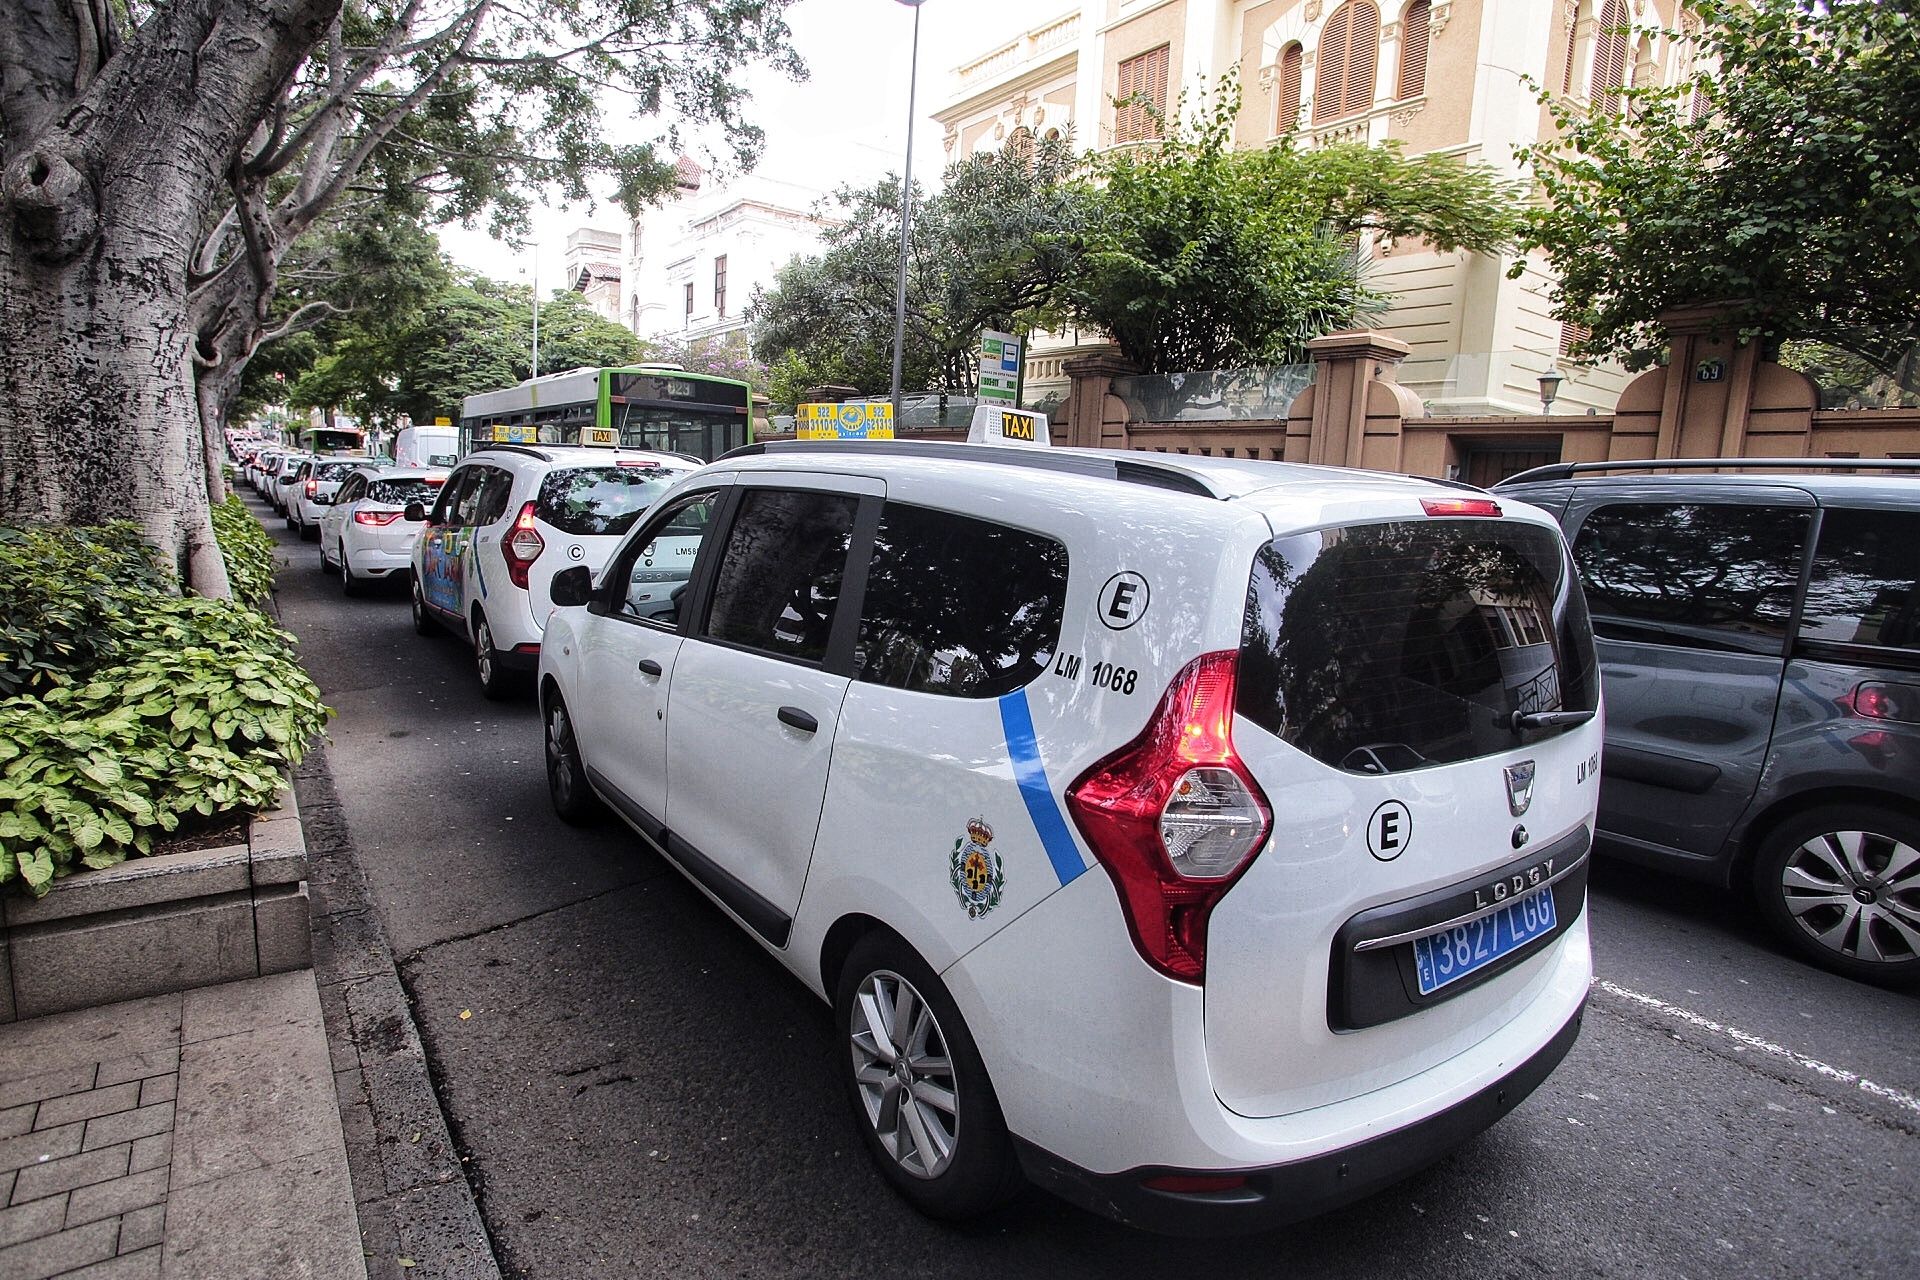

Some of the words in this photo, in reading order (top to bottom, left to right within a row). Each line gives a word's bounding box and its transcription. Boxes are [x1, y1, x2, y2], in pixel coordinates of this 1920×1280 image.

[817, 406, 830, 417] 922
[873, 406, 885, 417] 922
[810, 418, 838, 431] 311012
[866, 418, 893, 431] 621313
[1003, 413, 1034, 440] TAXI
[592, 430, 612, 442] TAXI
[675, 547, 698, 556] LM58
[1108, 581, 1138, 620] E
[1054, 651, 1082, 680] LM
[1091, 661, 1138, 695] 1068
[1577, 760, 1586, 785] LM
[1380, 811, 1399, 850] E
[1473, 858, 1555, 910] LODGY
[1436, 910, 1499, 975] 3827
[1507, 888, 1551, 942] LGG
[1423, 967, 1431, 982] E
